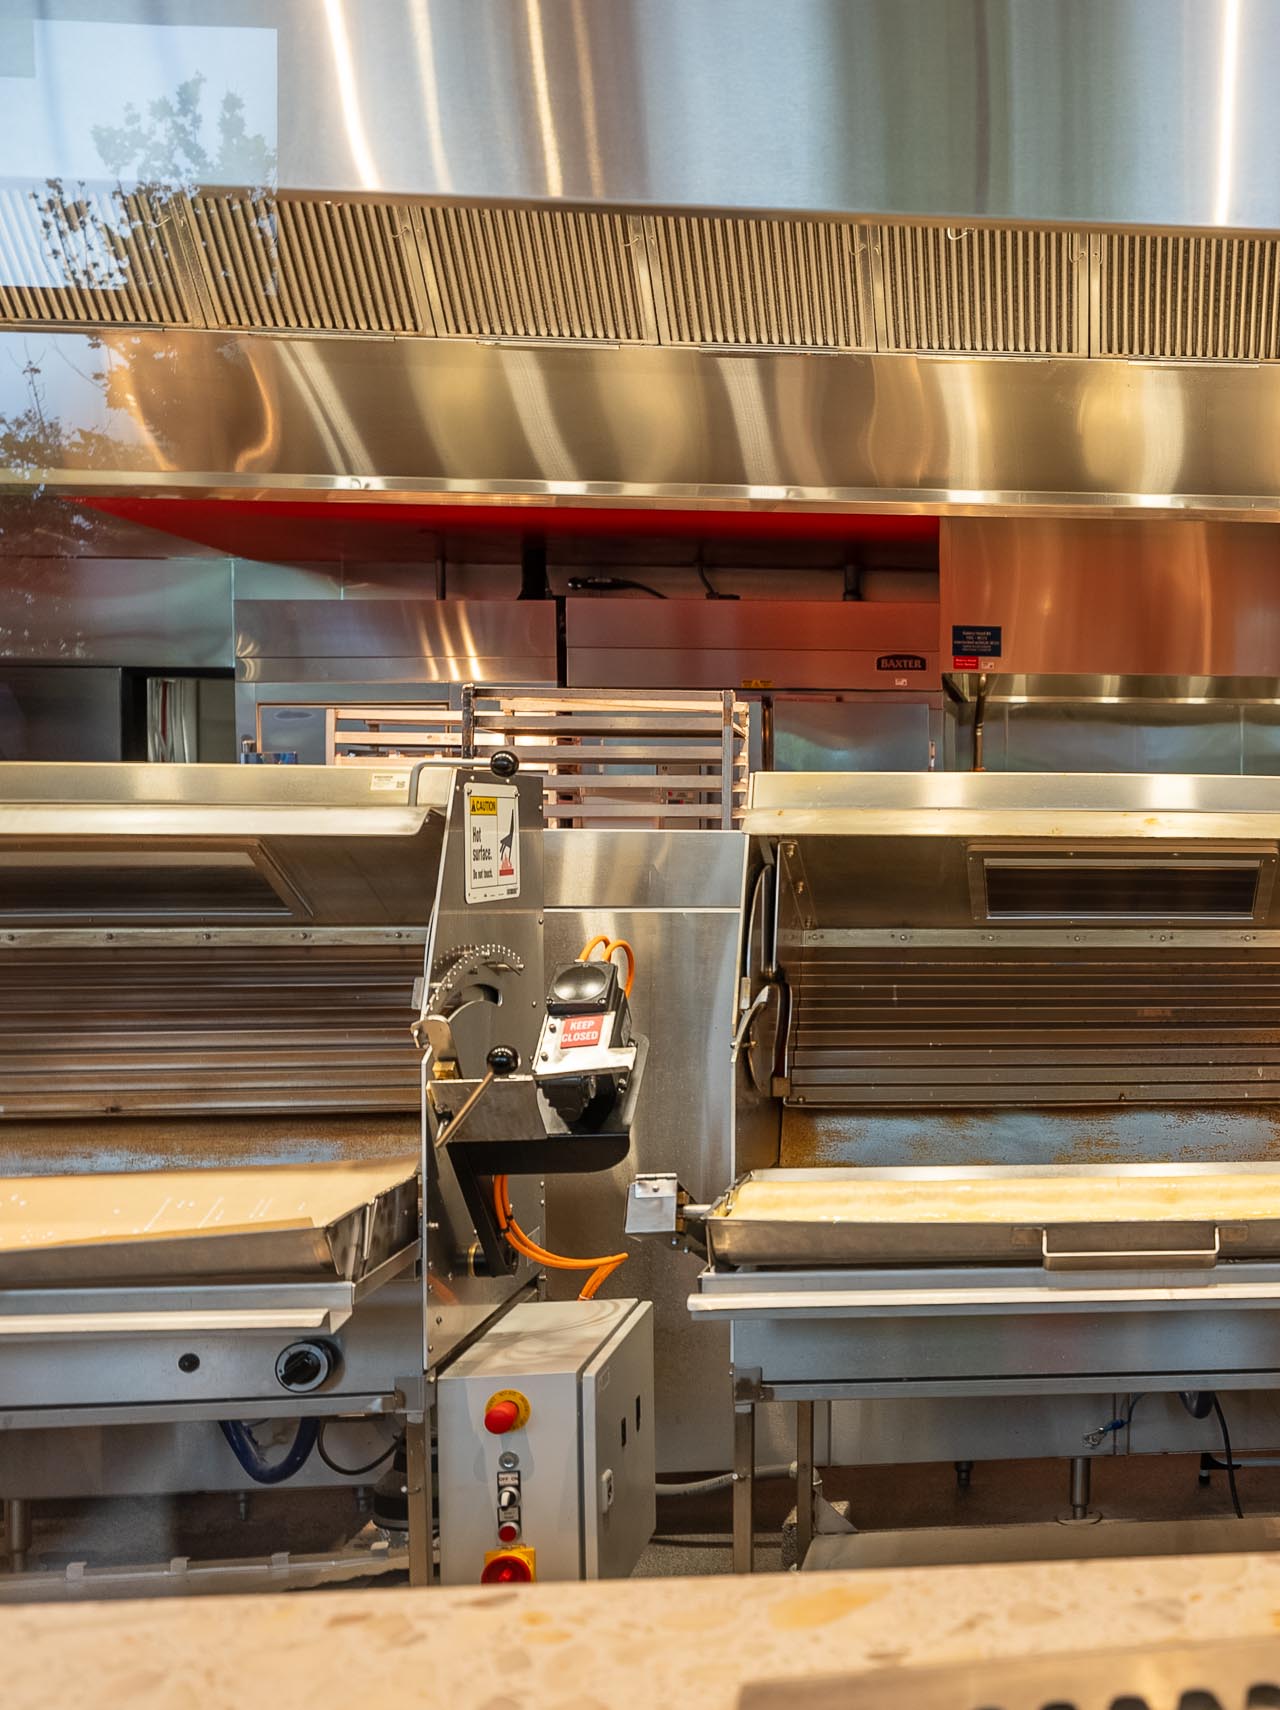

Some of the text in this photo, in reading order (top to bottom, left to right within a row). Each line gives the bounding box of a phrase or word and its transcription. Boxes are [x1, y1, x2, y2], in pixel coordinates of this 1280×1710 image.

[881, 659, 922, 668] BAXTER
[476, 800, 496, 812] CAUTION
[473, 826, 482, 843] Hot
[473, 845, 492, 861] surface.
[570, 1020, 595, 1030] KEEP
[562, 1031, 598, 1042] CLOSED
